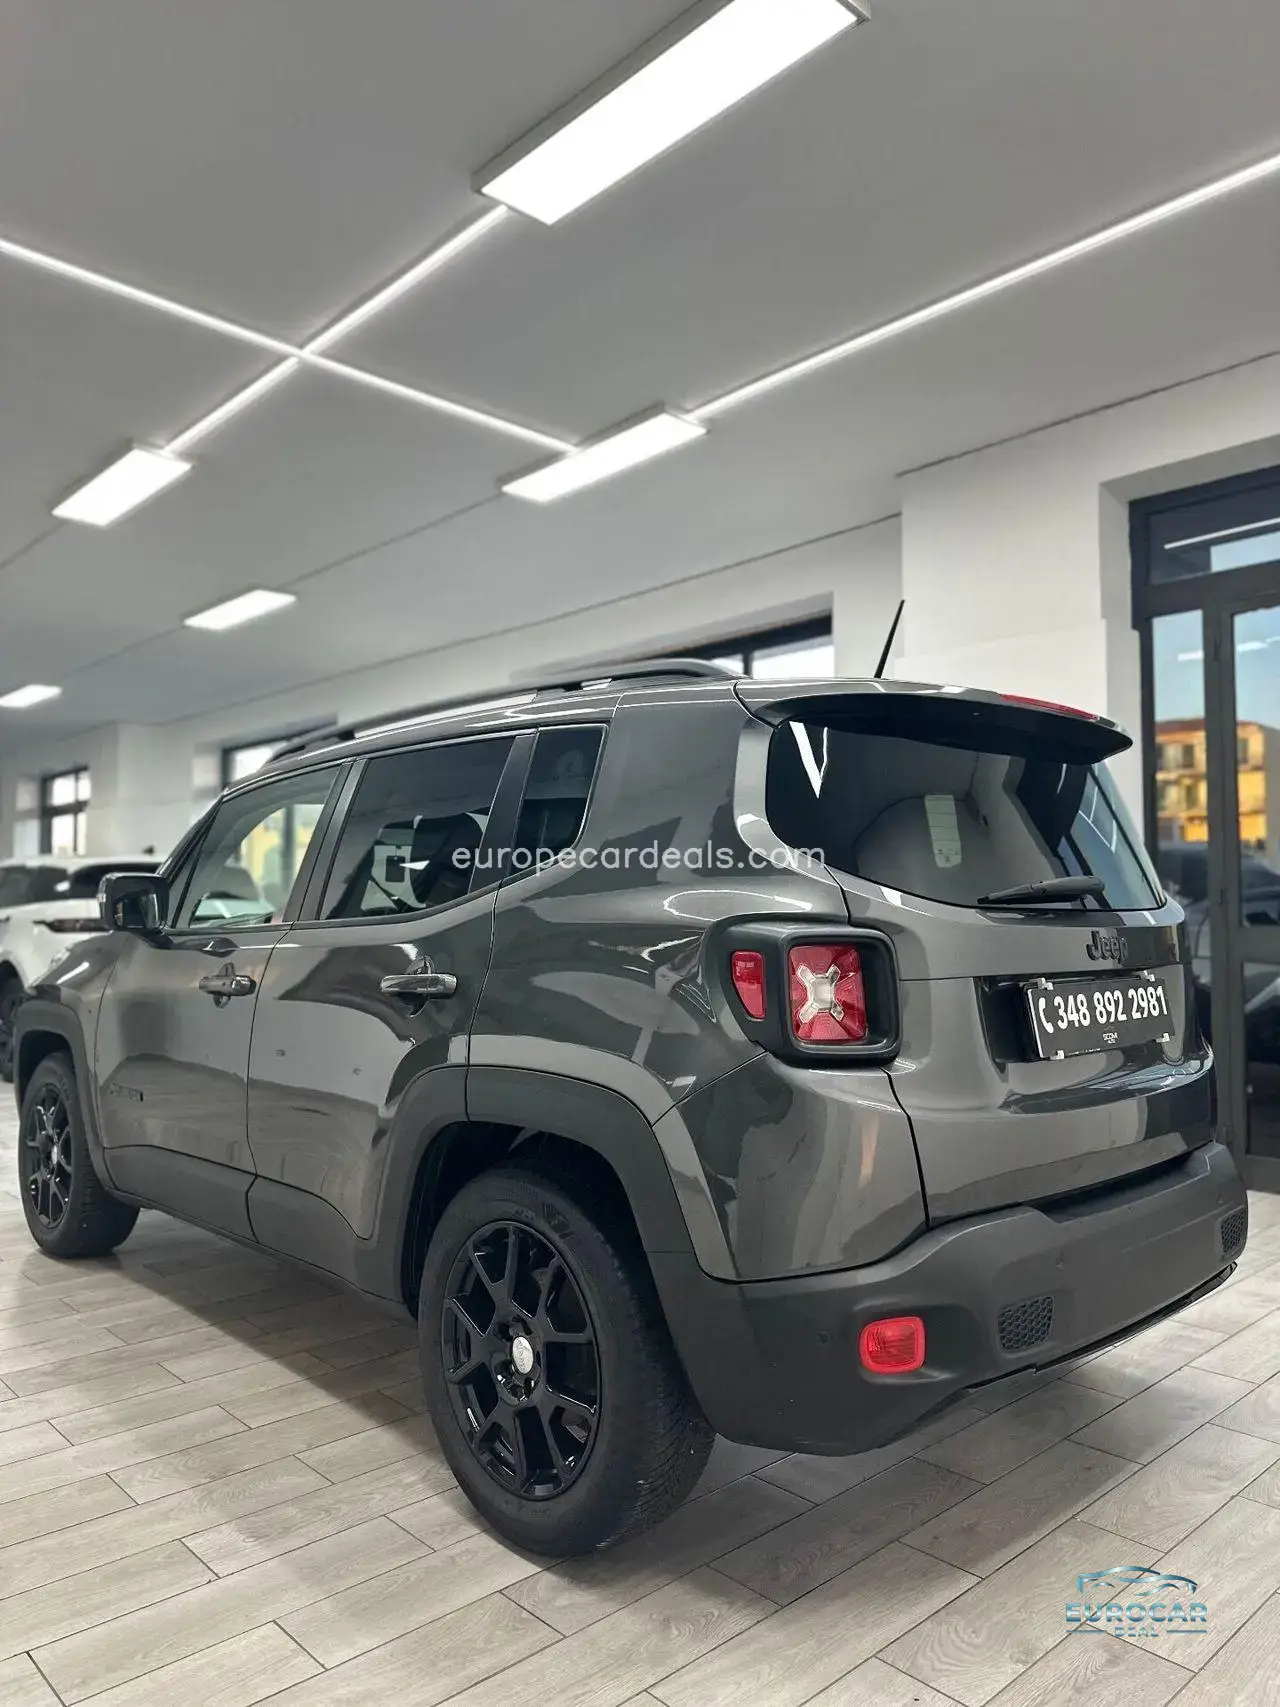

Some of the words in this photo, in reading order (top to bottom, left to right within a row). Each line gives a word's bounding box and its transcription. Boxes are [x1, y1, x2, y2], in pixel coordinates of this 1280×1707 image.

[1086, 930, 1128, 964] Jeep
[1054, 994, 1091, 1029] 348
[1093, 989, 1127, 1024] 892
[1128, 986, 1167, 1019] 2981
